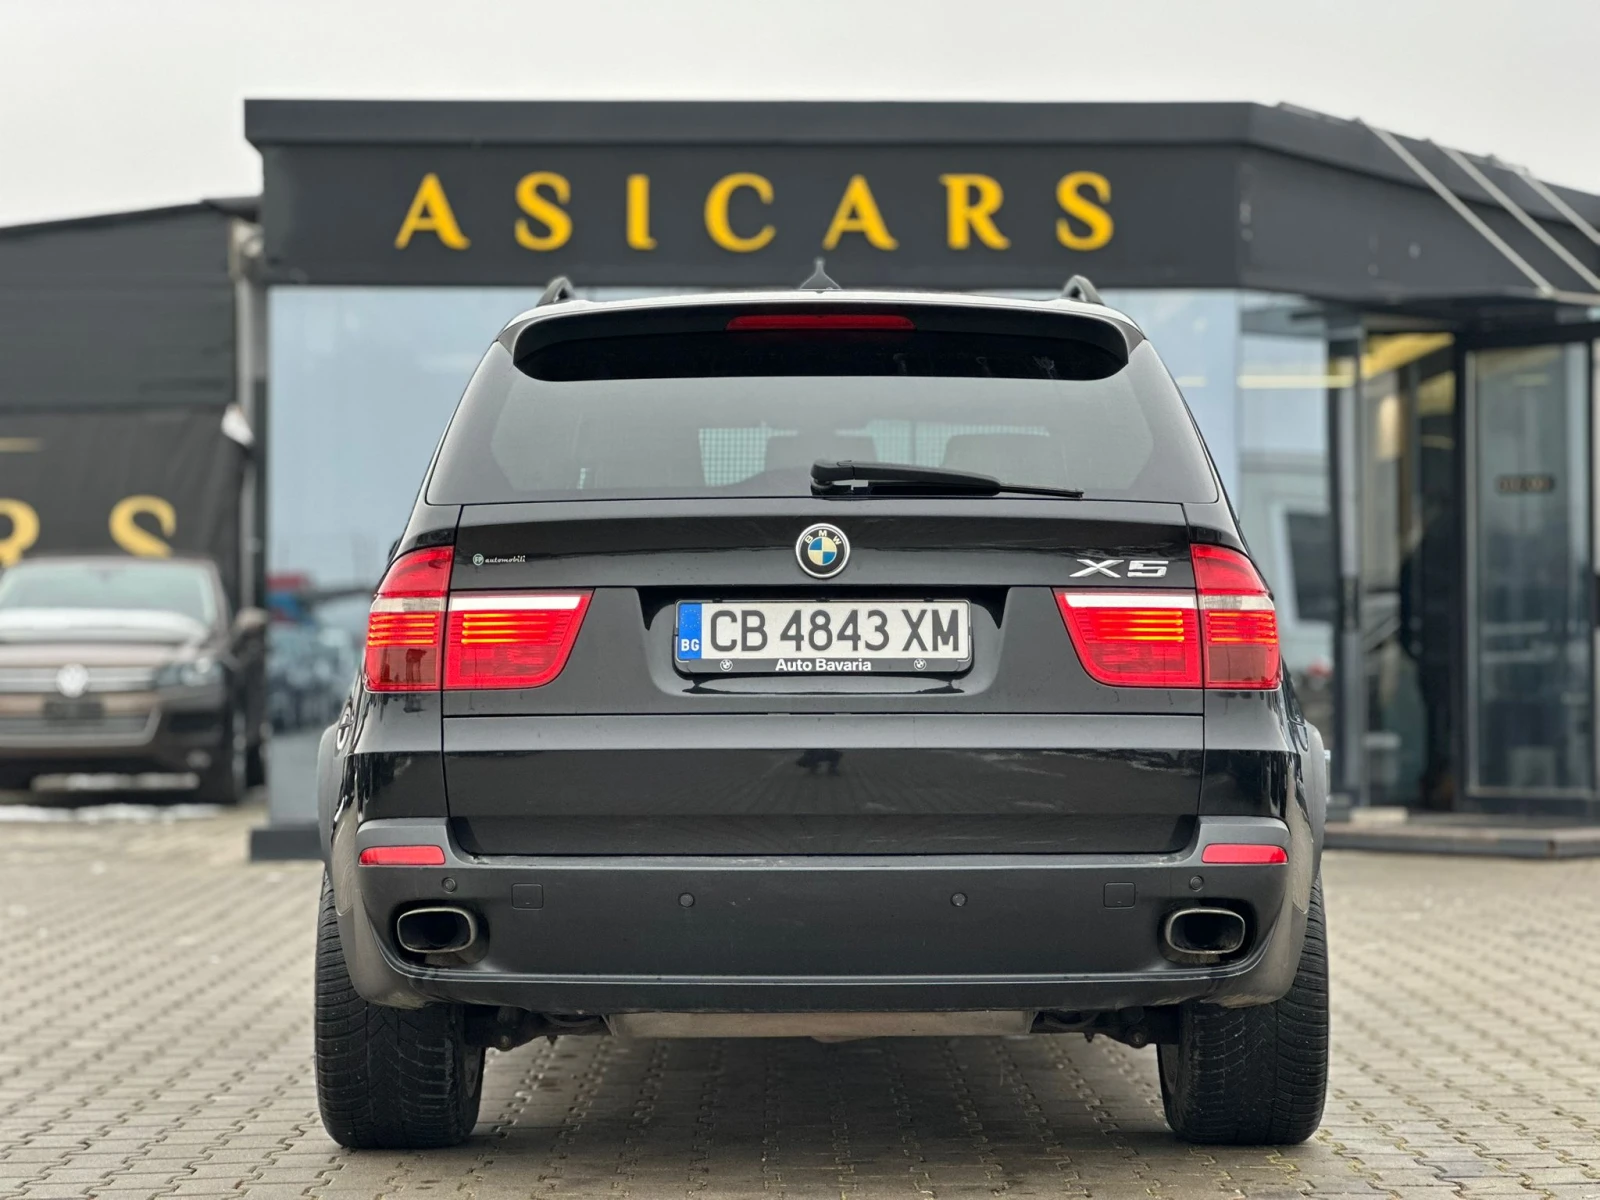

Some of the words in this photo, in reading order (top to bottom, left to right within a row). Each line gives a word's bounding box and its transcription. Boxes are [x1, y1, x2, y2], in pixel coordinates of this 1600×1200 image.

[394, 172, 1115, 252] ASICARS
[804, 529, 842, 545] BMW
[485, 555, 526, 563] automobili
[1069, 558, 1169, 578] X5
[710, 609, 768, 652] CB
[780, 609, 890, 652] 4843
[901, 609, 960, 652] XM
[681, 638, 700, 652] BG
[775, 658, 812, 671] Auto
[816, 658, 872, 671] Bavaria
